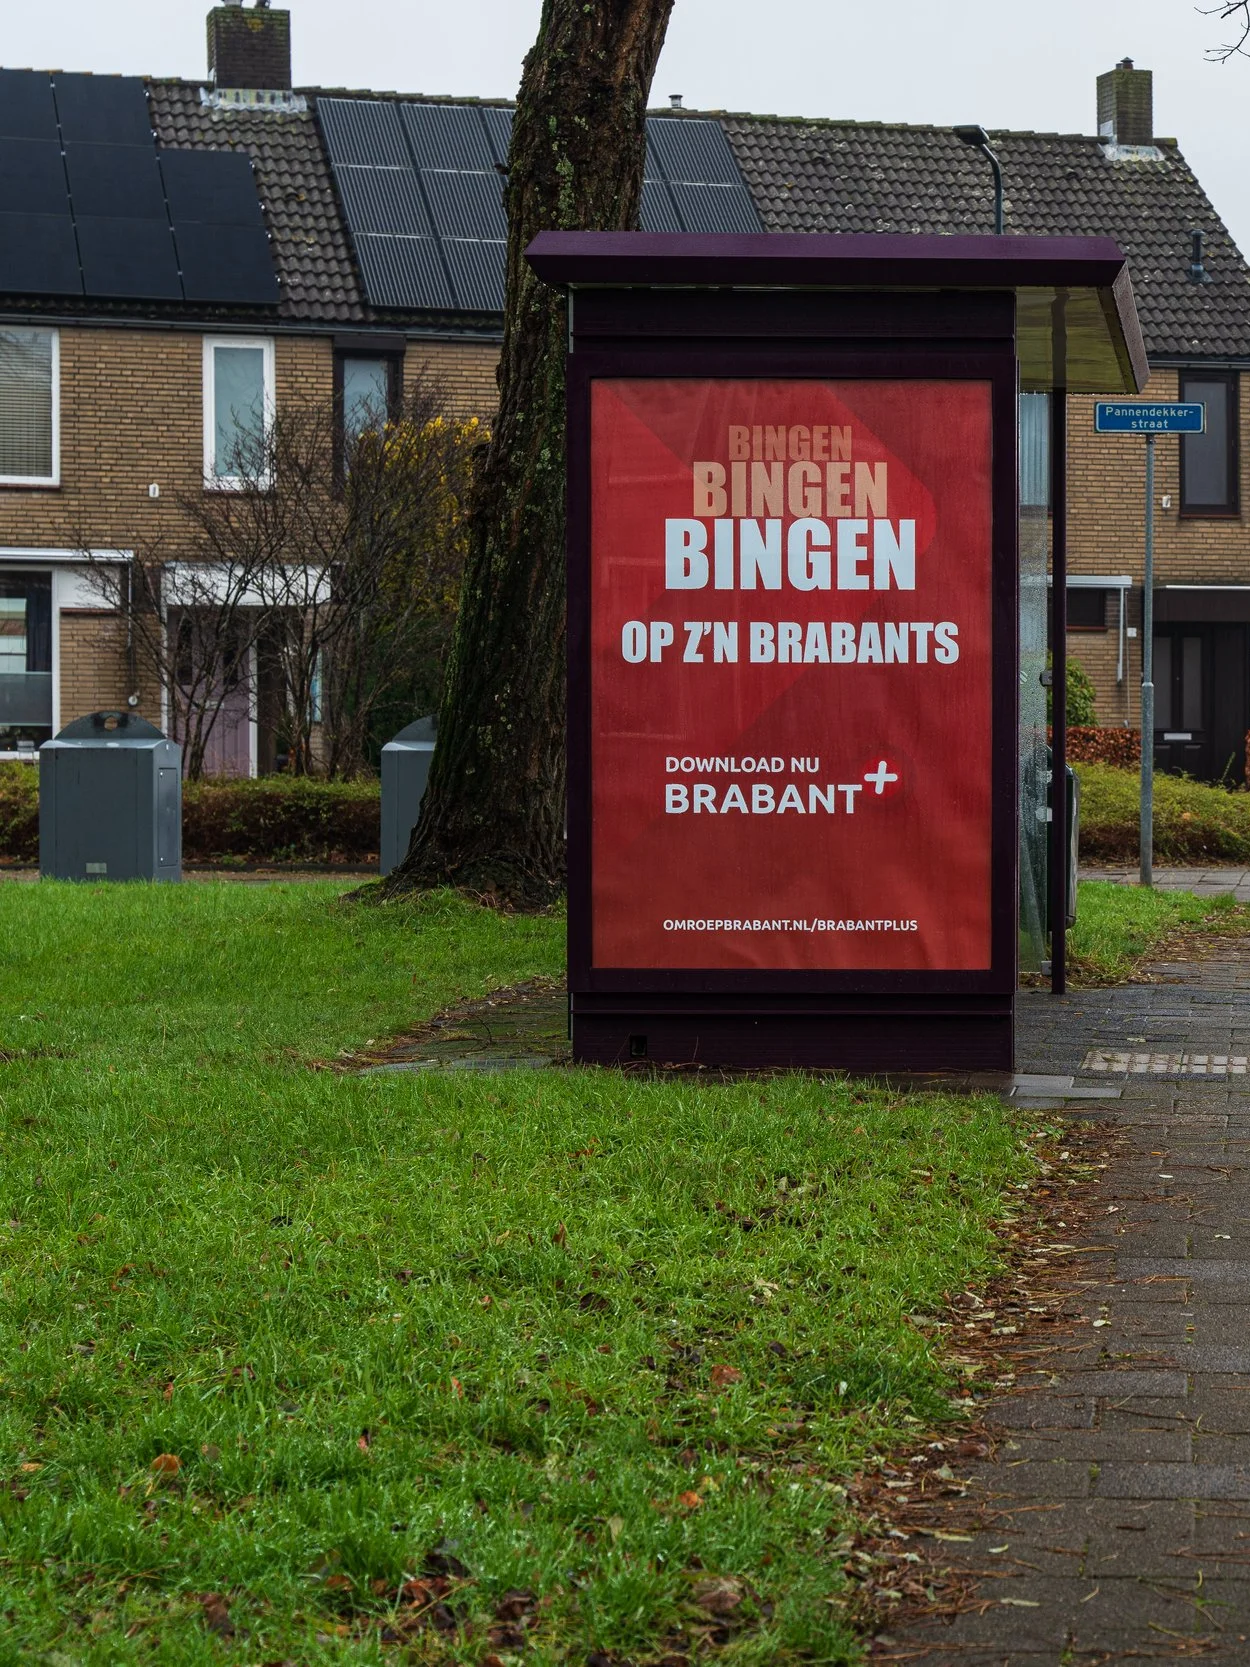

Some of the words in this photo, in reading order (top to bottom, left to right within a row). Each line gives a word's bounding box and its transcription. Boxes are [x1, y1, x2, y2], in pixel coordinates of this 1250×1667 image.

[1105, 406, 1194, 417] Pannendekker-
[1131, 419, 1169, 429] straat
[729, 425, 852, 461] BINGEN
[693, 461, 888, 517] BINGEN
[665, 518, 915, 590] BINGEN
[621, 621, 674, 664] OP
[683, 621, 739, 664] Z’N
[749, 621, 960, 665] BRABANTS
[665, 756, 785, 773] DOWNLOAD
[791, 756, 820, 773] NU
[663, 917, 918, 933] OMROEPBRABANT.NL/BRABANTPLUS
